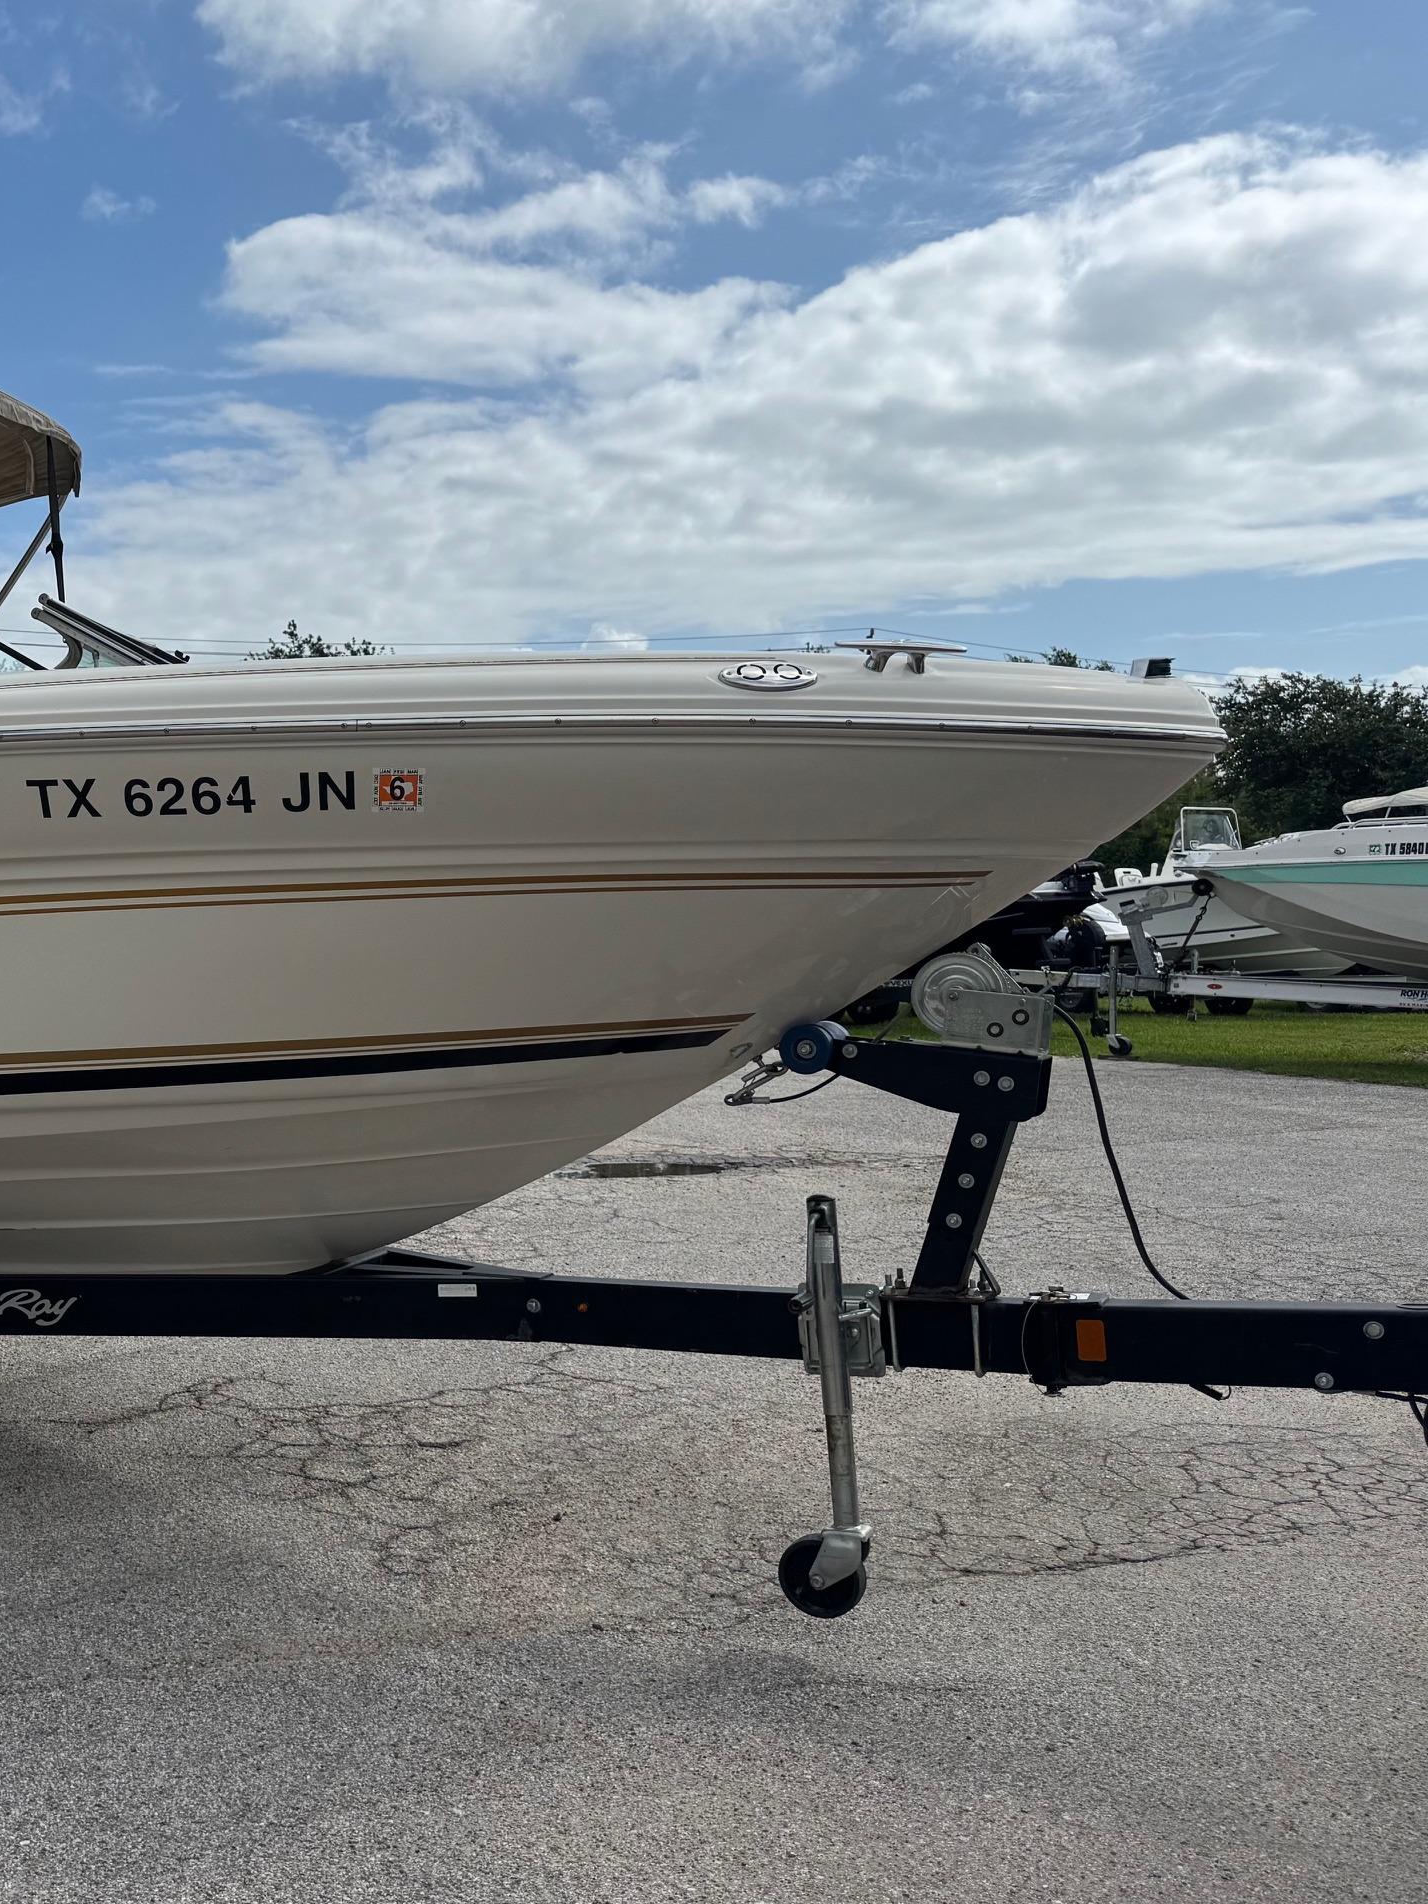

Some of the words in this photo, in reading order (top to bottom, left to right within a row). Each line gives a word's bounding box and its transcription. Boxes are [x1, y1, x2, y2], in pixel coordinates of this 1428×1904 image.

[25, 777, 103, 819] TX
[123, 775, 257, 817] 6264
[282, 770, 357, 813] JN
[390, 776, 405, 801] 6
[1384, 842, 1397, 856] TX
[1400, 989, 1420, 998] RON
